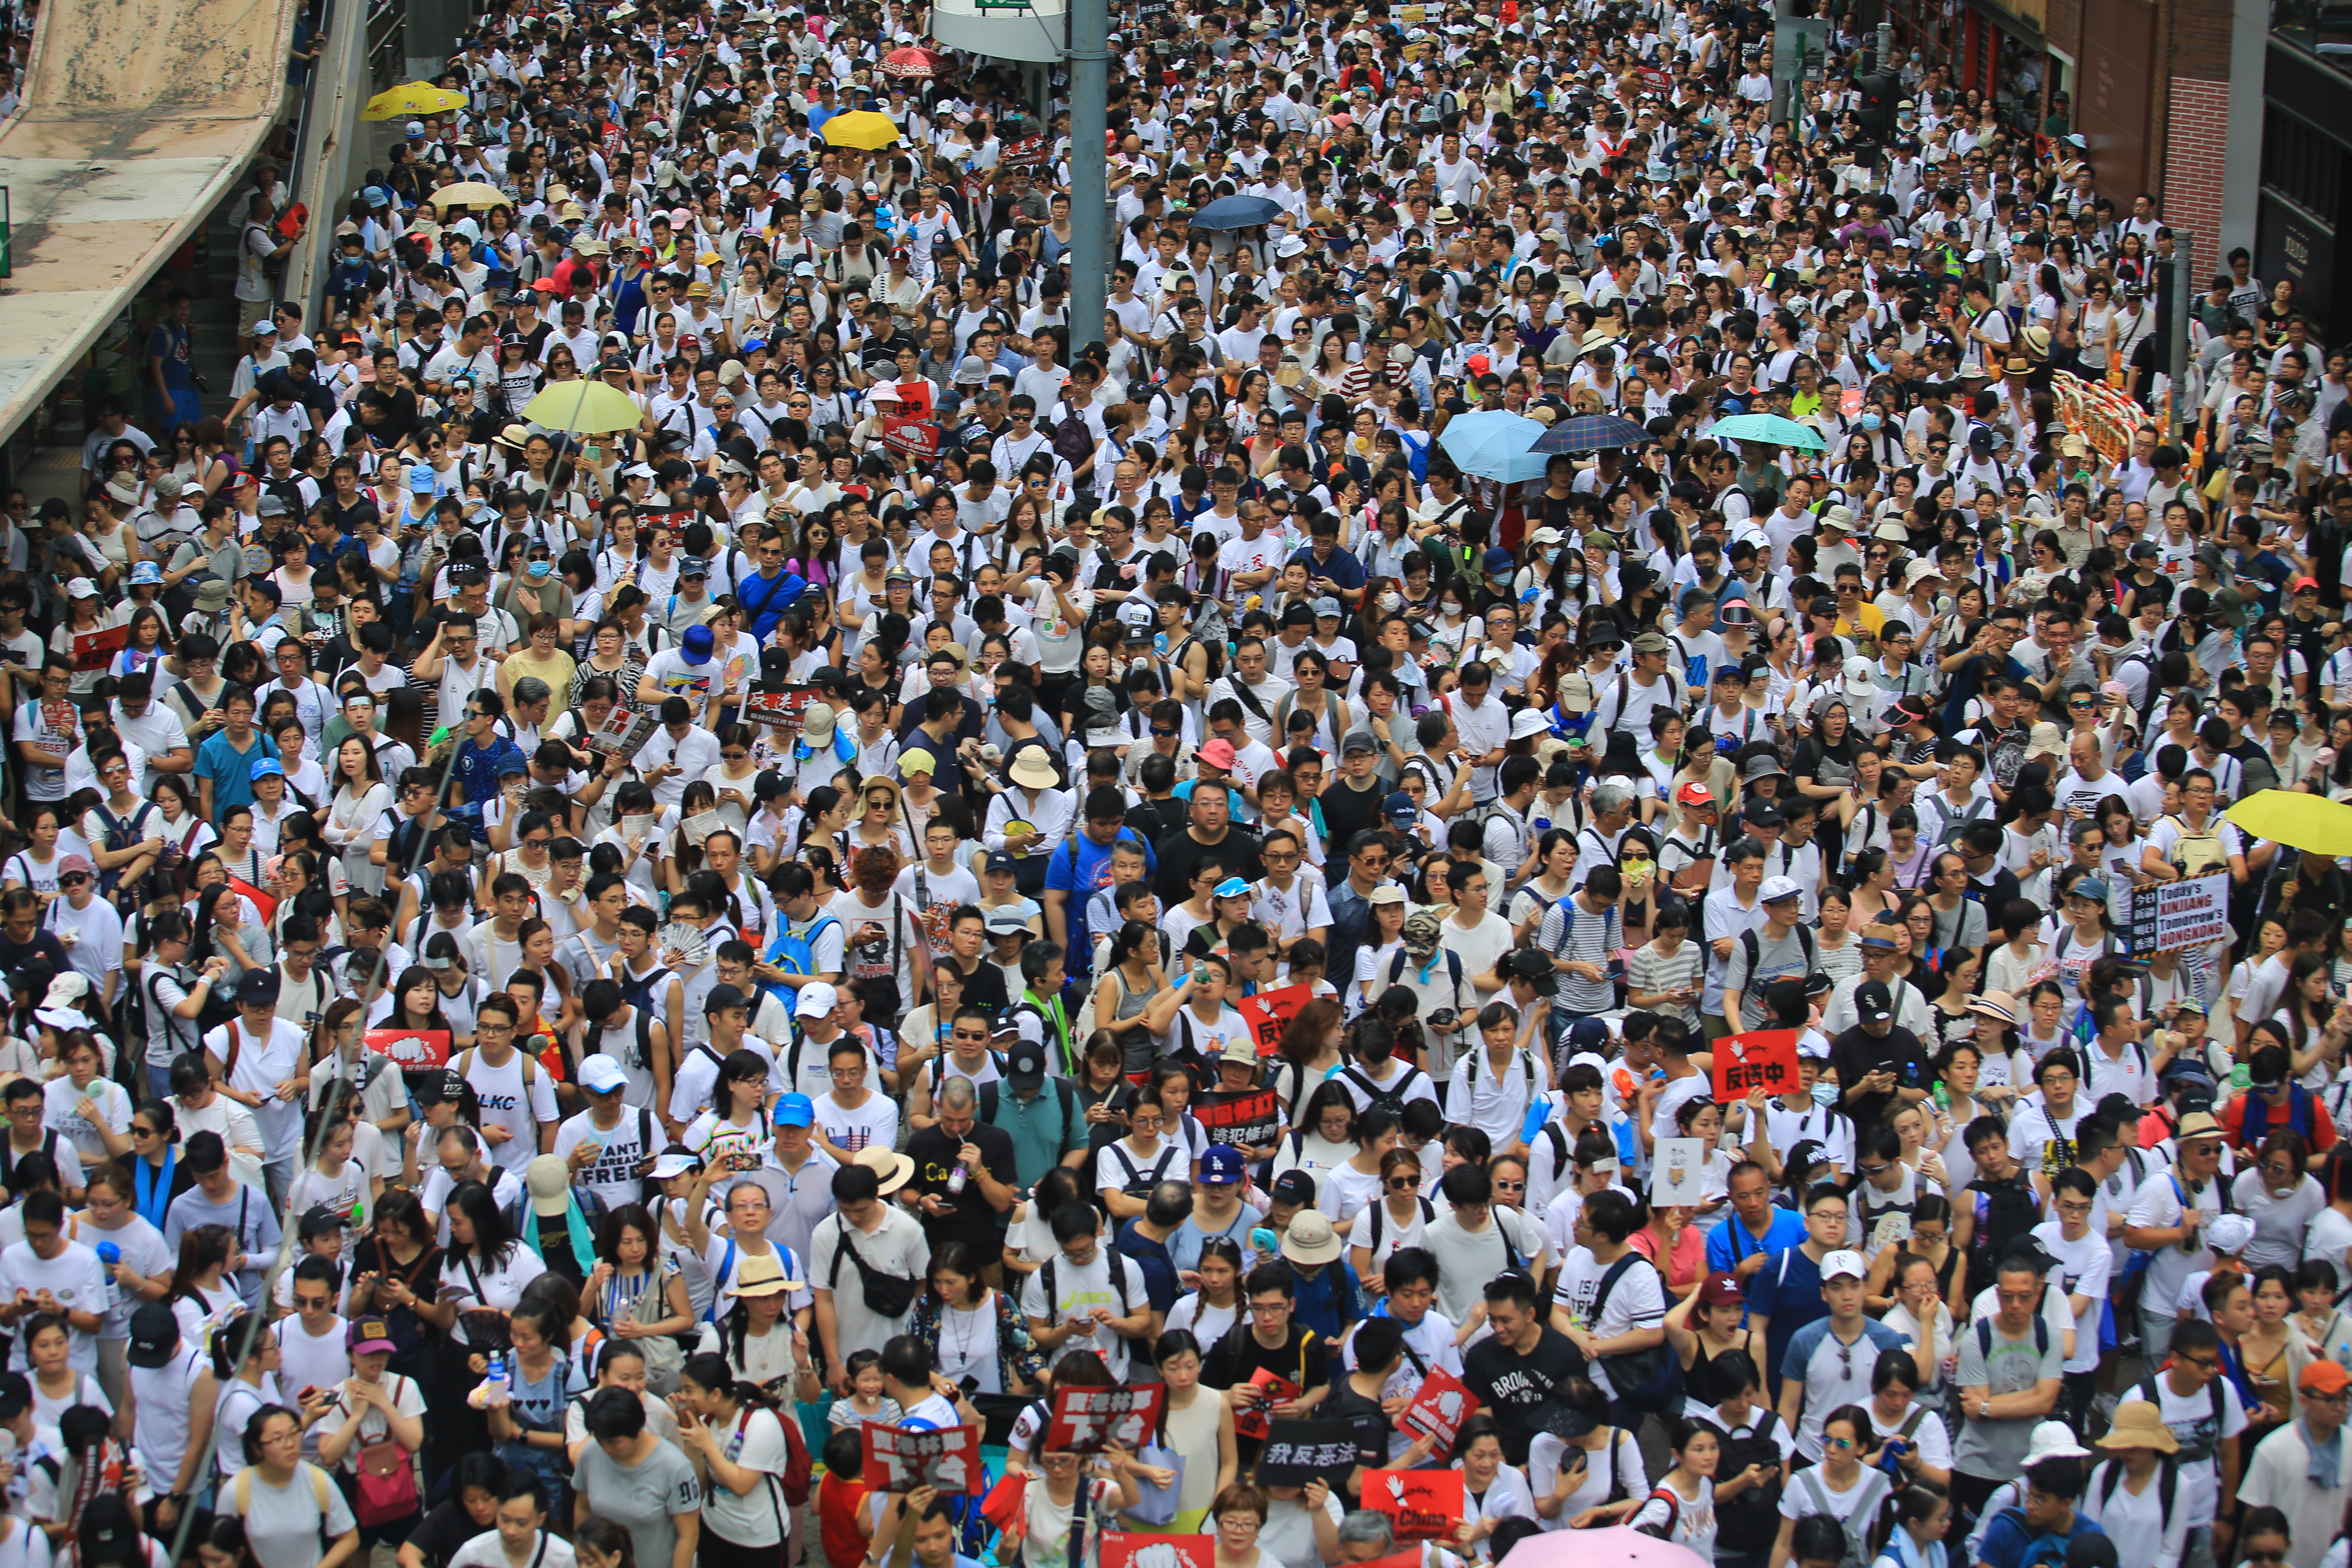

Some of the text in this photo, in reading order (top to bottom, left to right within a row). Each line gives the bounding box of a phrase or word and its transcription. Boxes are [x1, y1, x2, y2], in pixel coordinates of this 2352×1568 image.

[746, 690, 820, 716] 反送中
[41, 726, 60, 735] LIF
[36, 742, 69, 753] RESET
[2134, 892, 2156, 905] 今日
[2160, 884, 2201, 901] Today's
[2159, 895, 2212, 916] XINJIANG
[2134, 922, 2156, 935] 明日
[2160, 909, 2223, 931] Tomorrow's
[2159, 924, 2223, 947] HONGKONG
[1731, 1062, 1785, 1091] 反送中
[475, 1094, 516, 1111] LKC
[1212, 1123, 1278, 1143] 逃犯條例
[606, 1142, 639, 1158] ANT
[1078, 1292, 1112, 1303] asics
[1064, 1388, 1155, 1413] 賣港林鄭
[871, 1430, 967, 1455] 賣港林鄭
[1399, 1510, 1447, 1528] China
